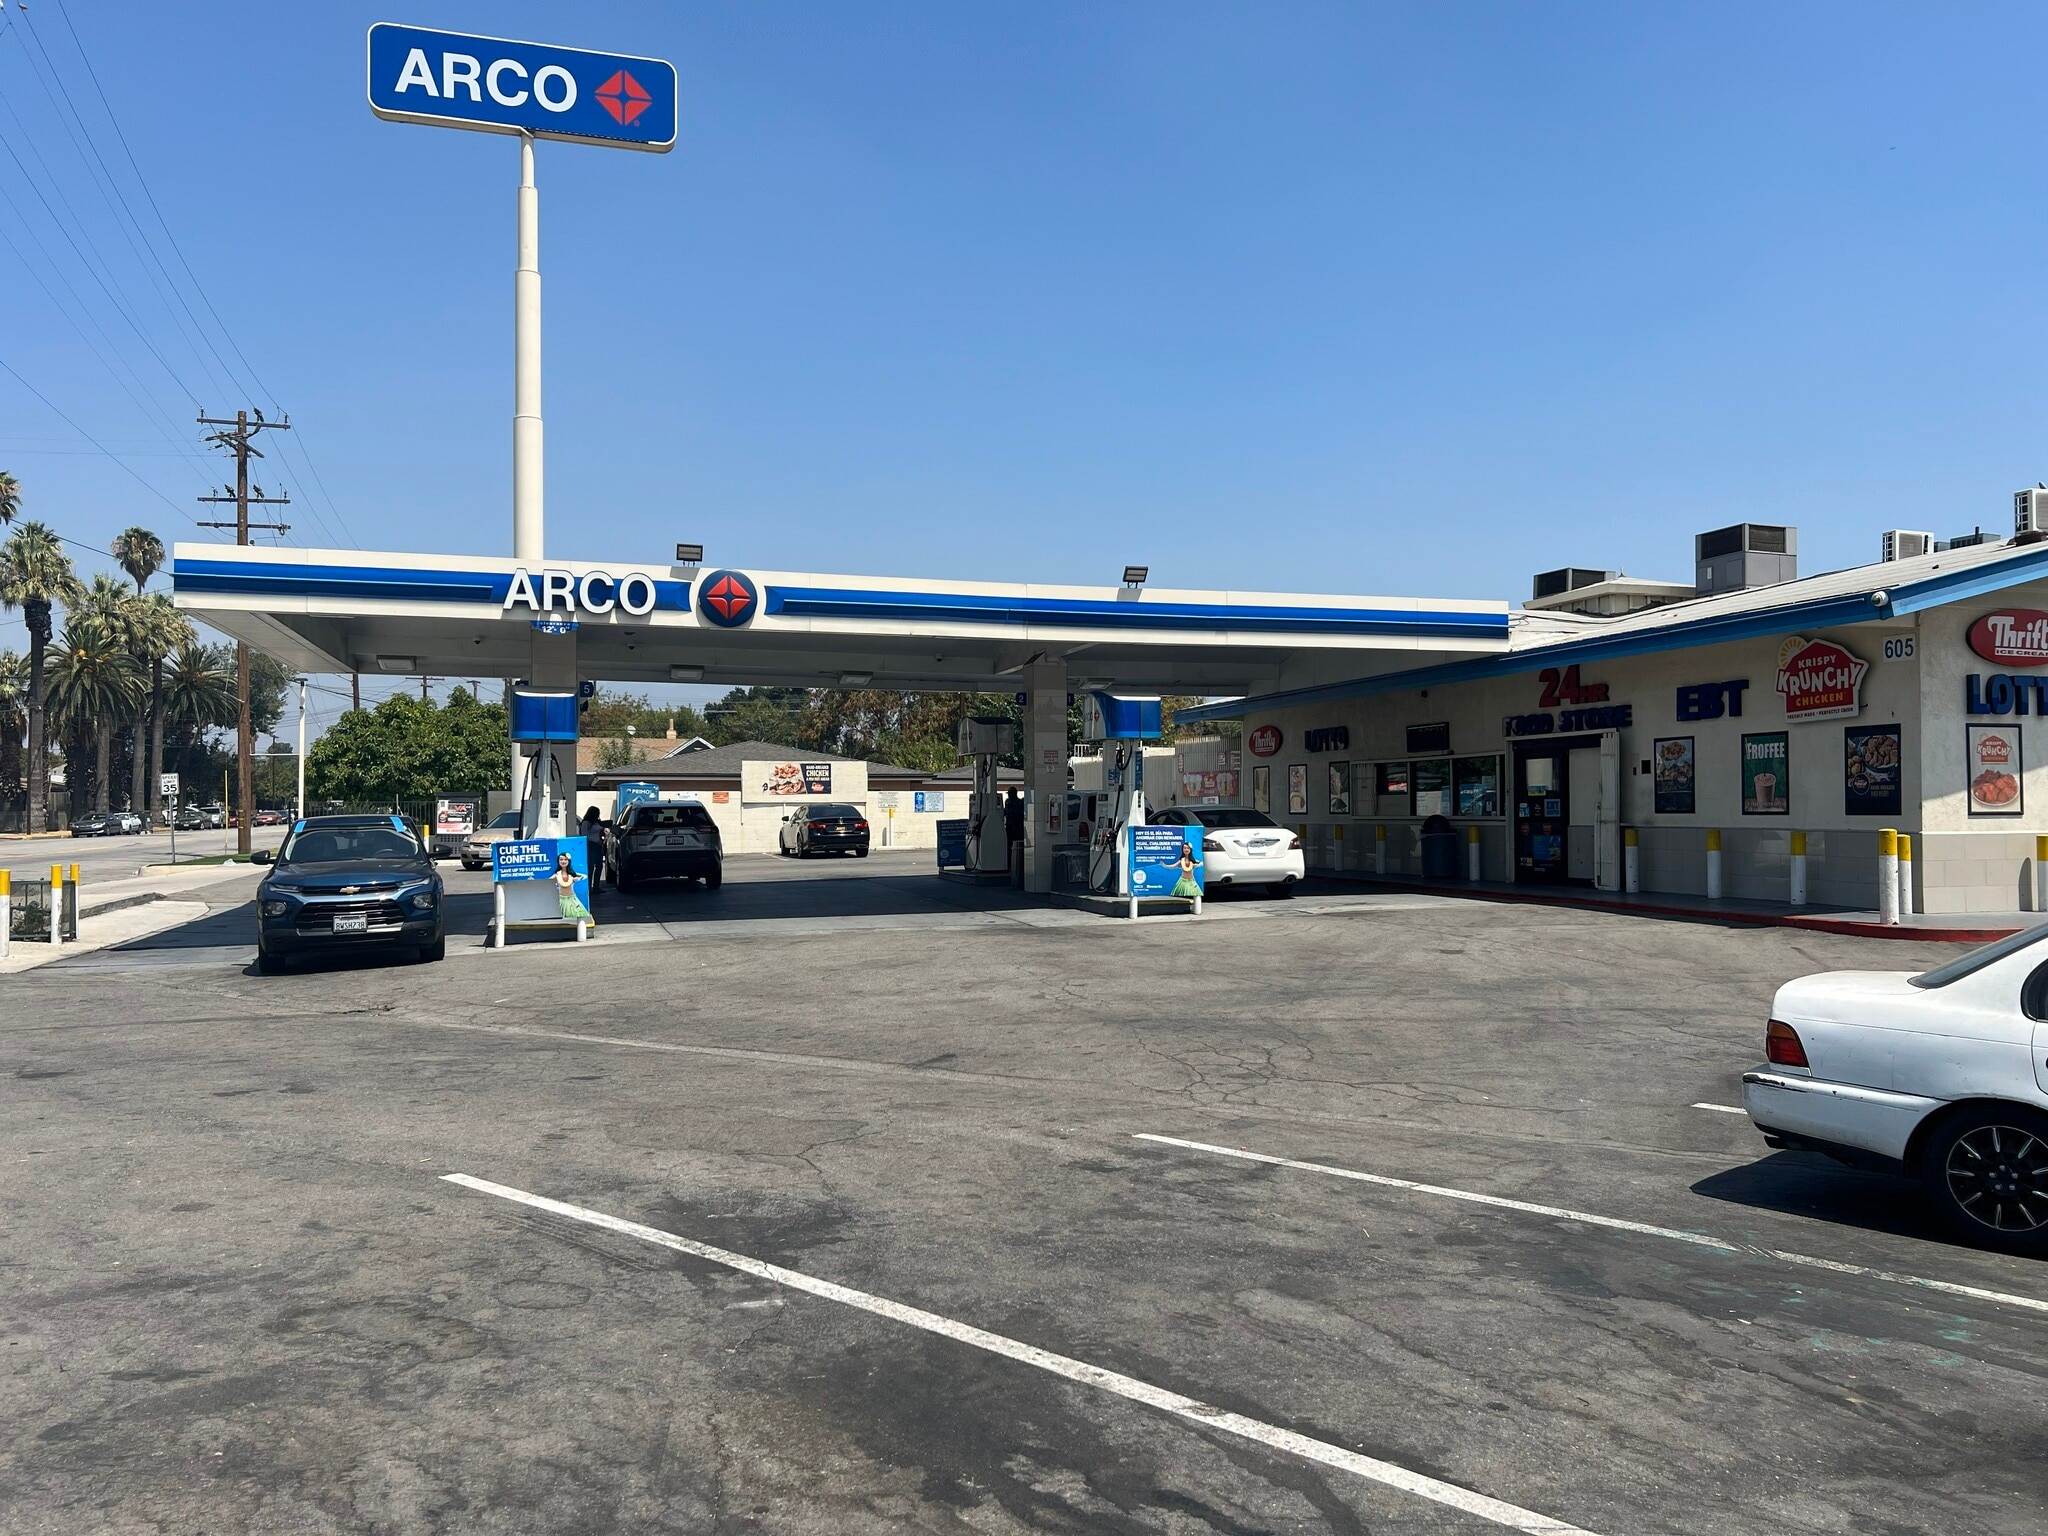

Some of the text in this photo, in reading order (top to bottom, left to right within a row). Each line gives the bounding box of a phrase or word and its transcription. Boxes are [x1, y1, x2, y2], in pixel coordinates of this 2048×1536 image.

[394, 47, 578, 113] ARCO
[502, 568, 657, 616] ARCO
[1884, 638, 1914, 659] 605
[1798, 654, 1837, 669] KRISPY
[1777, 662, 1862, 696] KRUNCHY
[583, 685, 590, 694] 5
[1018, 694, 1024, 703] 2
[1676, 679, 1750, 722] EBT
[1795, 691, 1844, 707] CHICKEN
[1559, 704, 1632, 732] STORE
[1252, 730, 1276, 751] Thrifty
[1745, 741, 1785, 760] FROFFEE
[1977, 745, 2011, 757] KRUNCHY
[806, 769, 829, 777] CHICKEN
[163, 784, 177, 793] 35
[499, 845, 519, 855] CUE
[520, 844, 540, 854] THE
[499, 853, 550, 865] CONFETTI.
